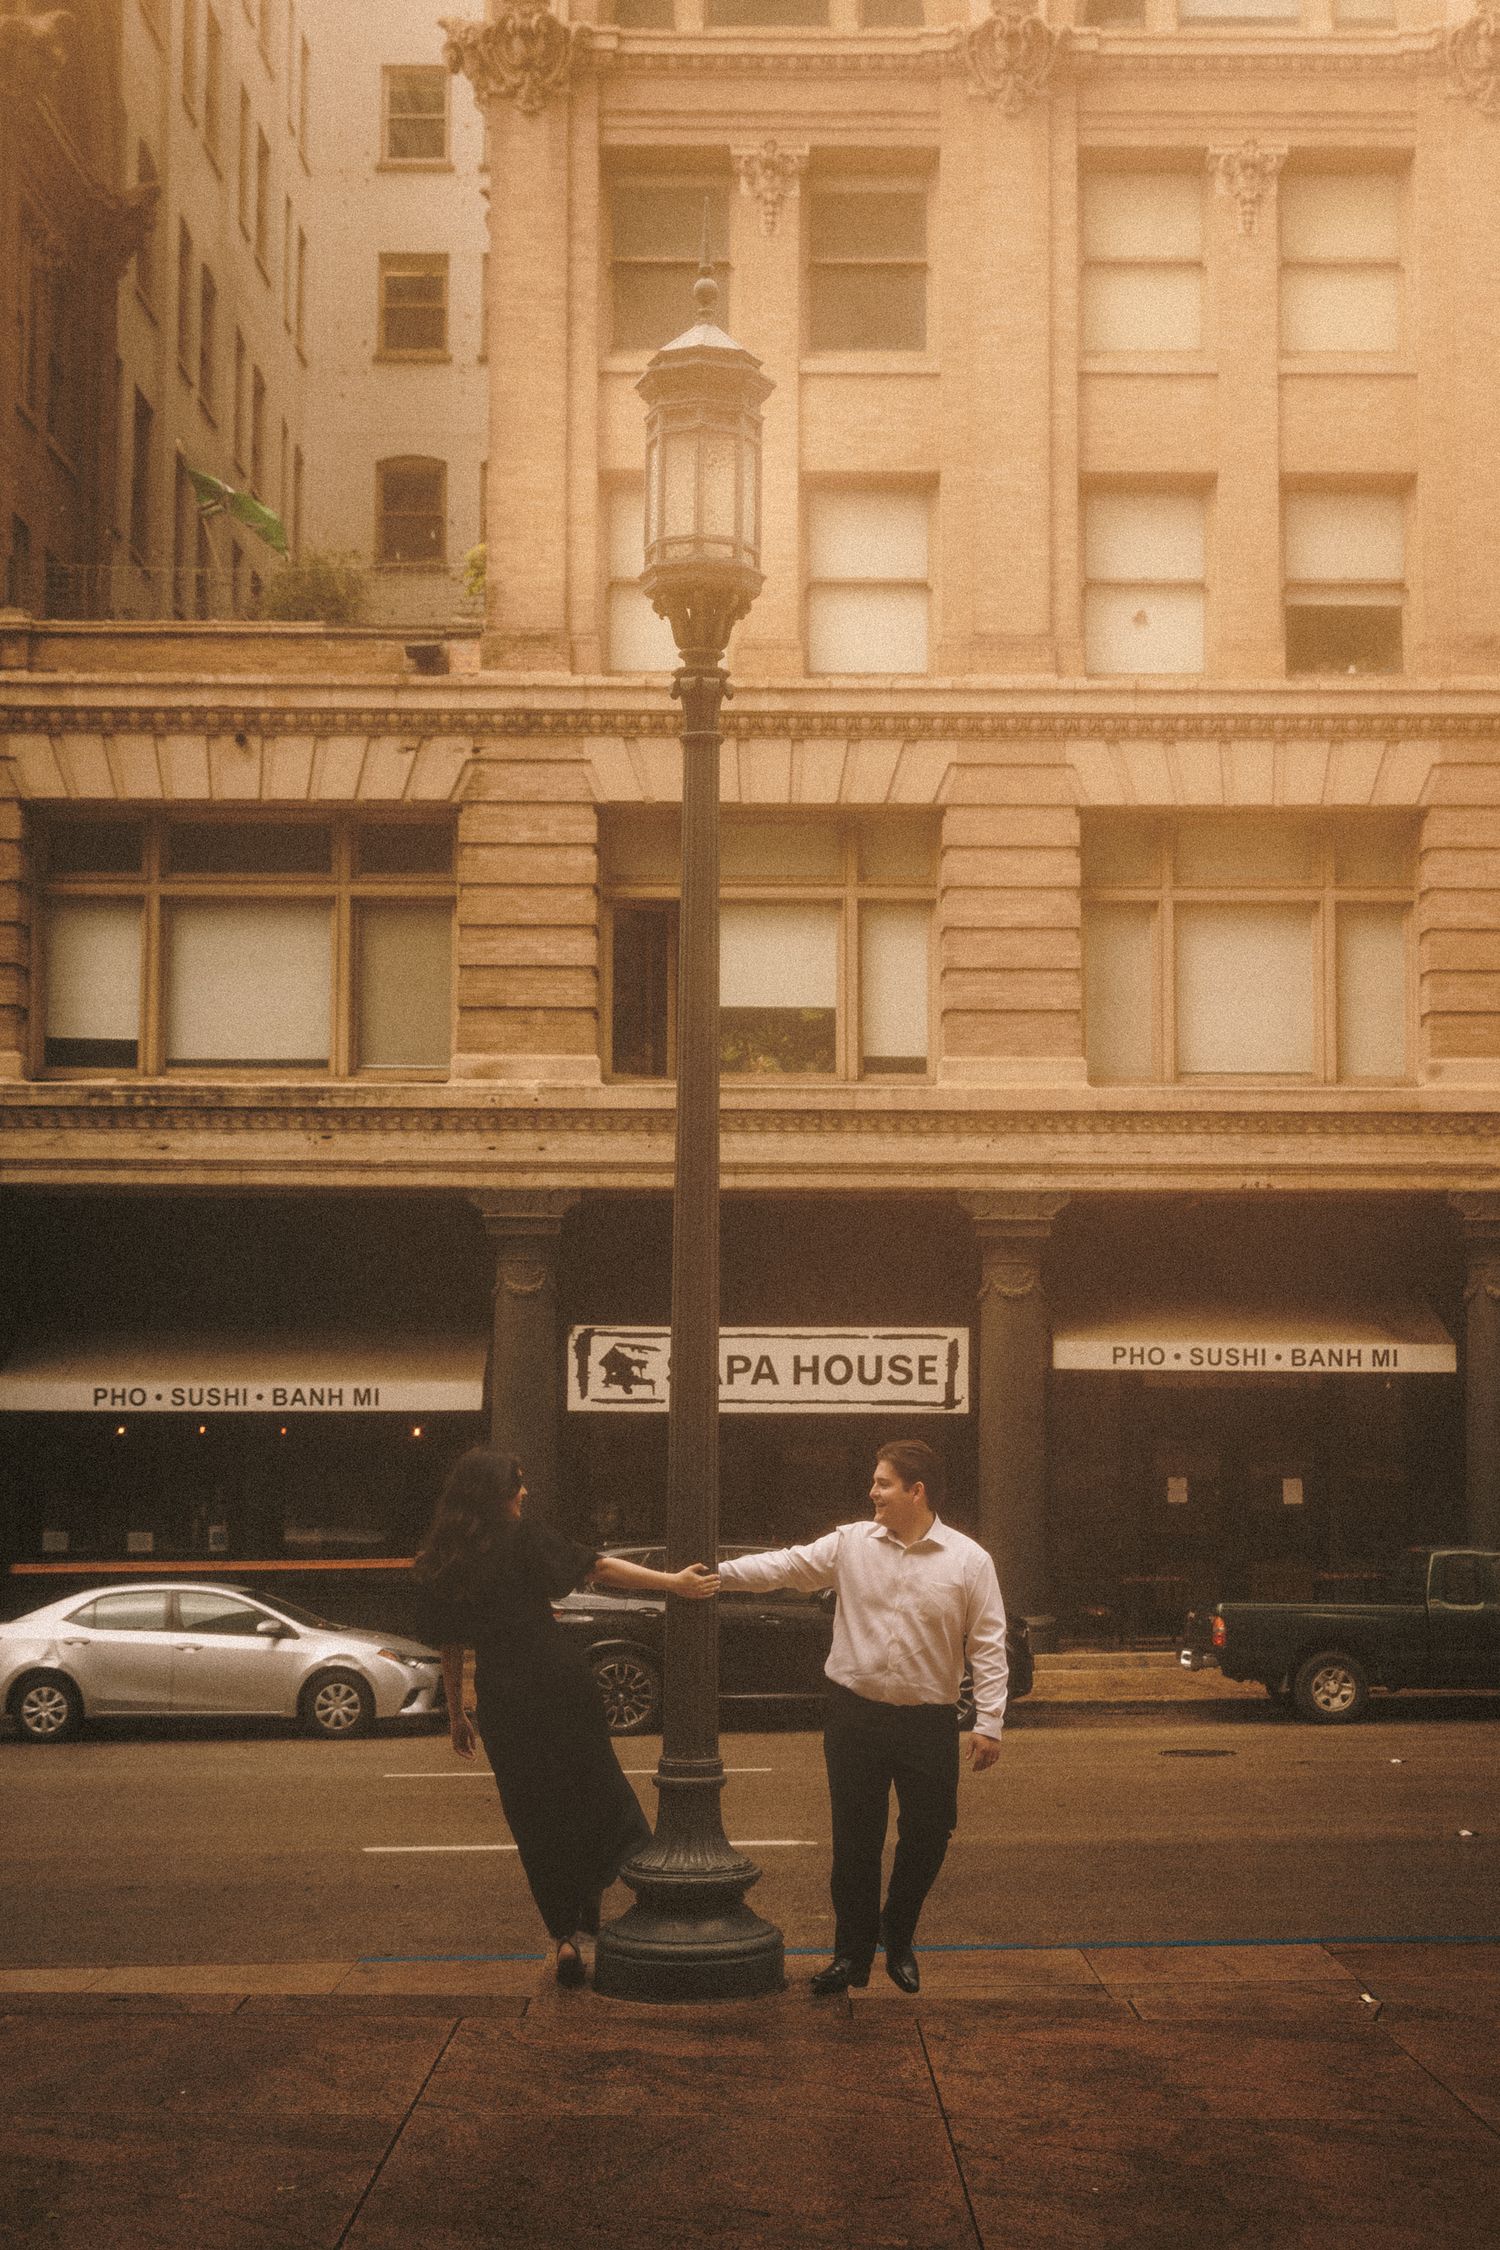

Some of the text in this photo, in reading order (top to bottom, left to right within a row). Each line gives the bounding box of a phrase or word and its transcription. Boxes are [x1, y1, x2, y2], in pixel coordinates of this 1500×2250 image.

[1112, 1346, 1398, 1368] PHO SUSHI BANH MI
[793, 1354, 939, 1386] HOUSE
[93, 1387, 380, 1407] PHO SUSHI BANH MI
